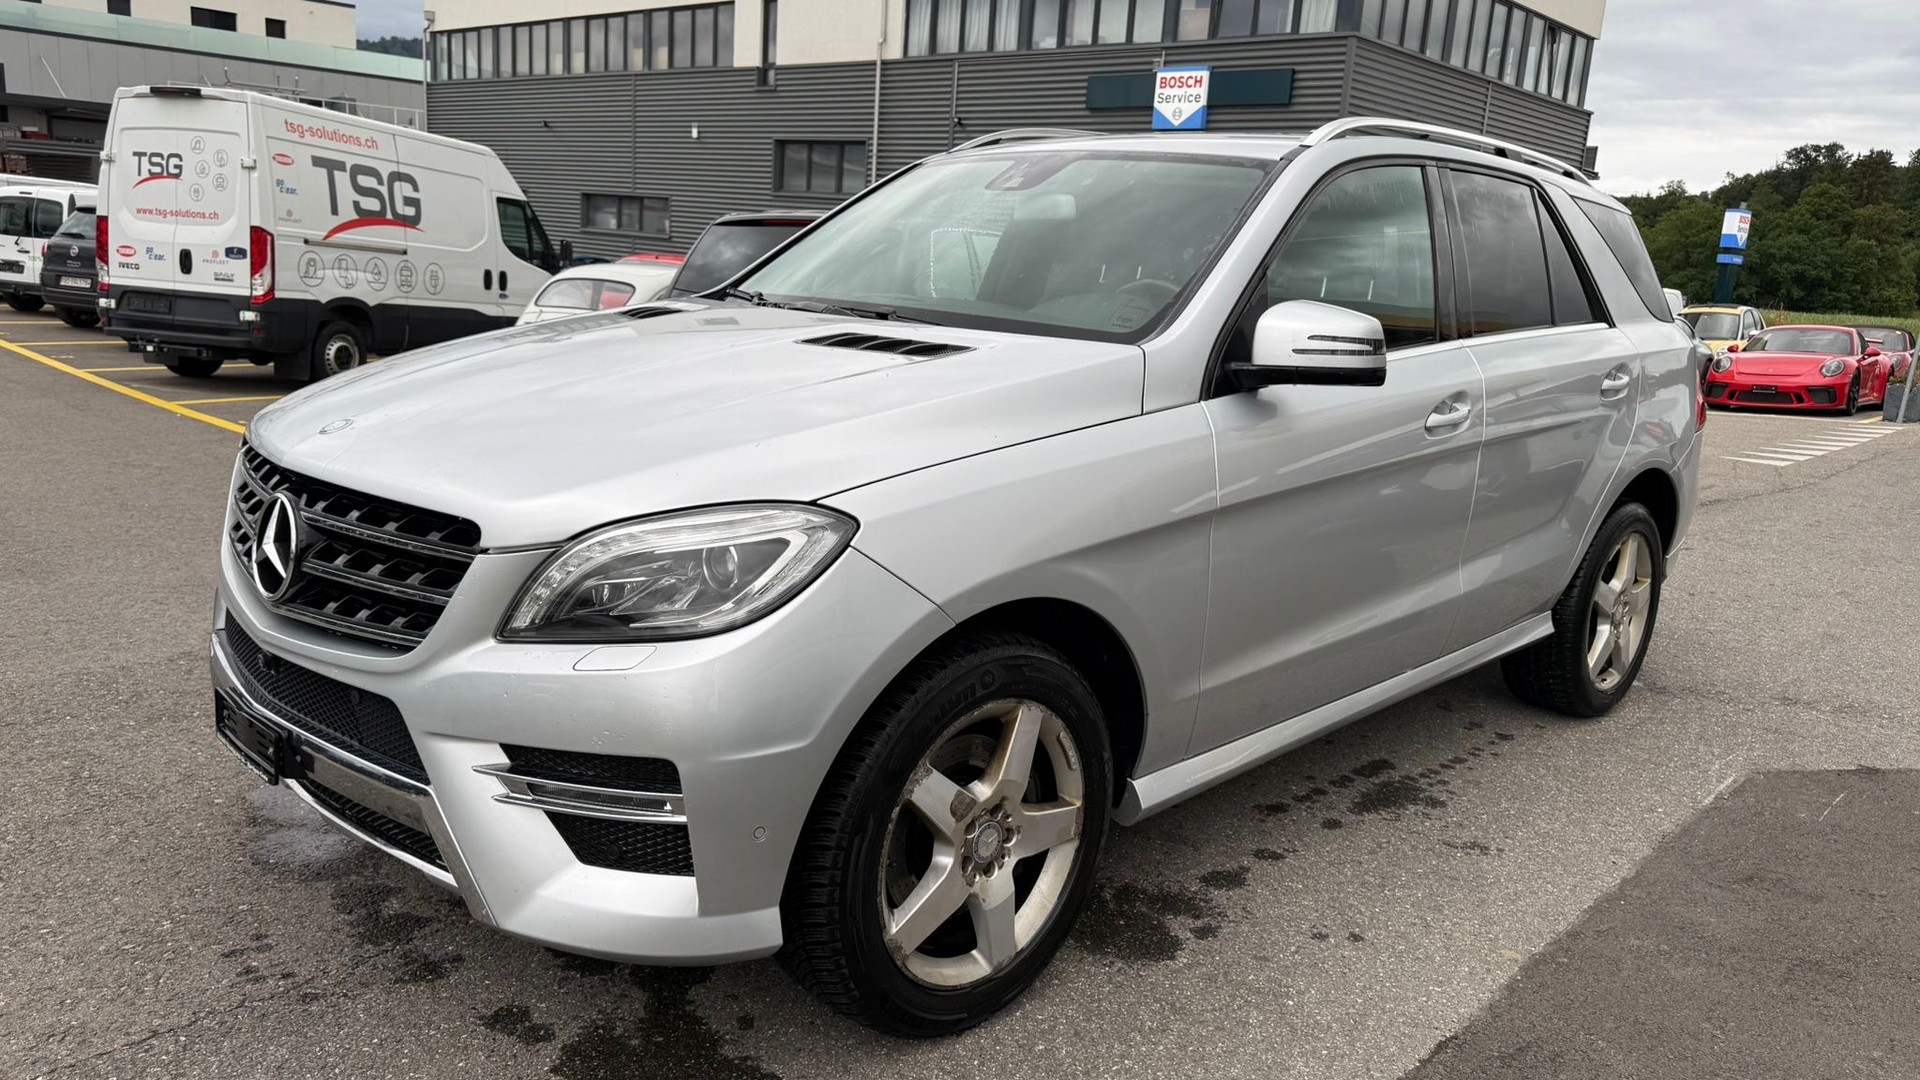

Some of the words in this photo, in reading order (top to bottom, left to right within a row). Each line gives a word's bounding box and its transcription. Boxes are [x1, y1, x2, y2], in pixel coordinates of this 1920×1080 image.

[1158, 75, 1203, 89] BOSCH
[1157, 91, 1202, 104] Service
[284, 118, 378, 150] tsg-solutions.ch
[132, 151, 183, 179] TSG
[310, 155, 422, 227] TSG
[136, 206, 219, 220] www.tsg-solutions.ch
[118, 261, 140, 270] IVECO
